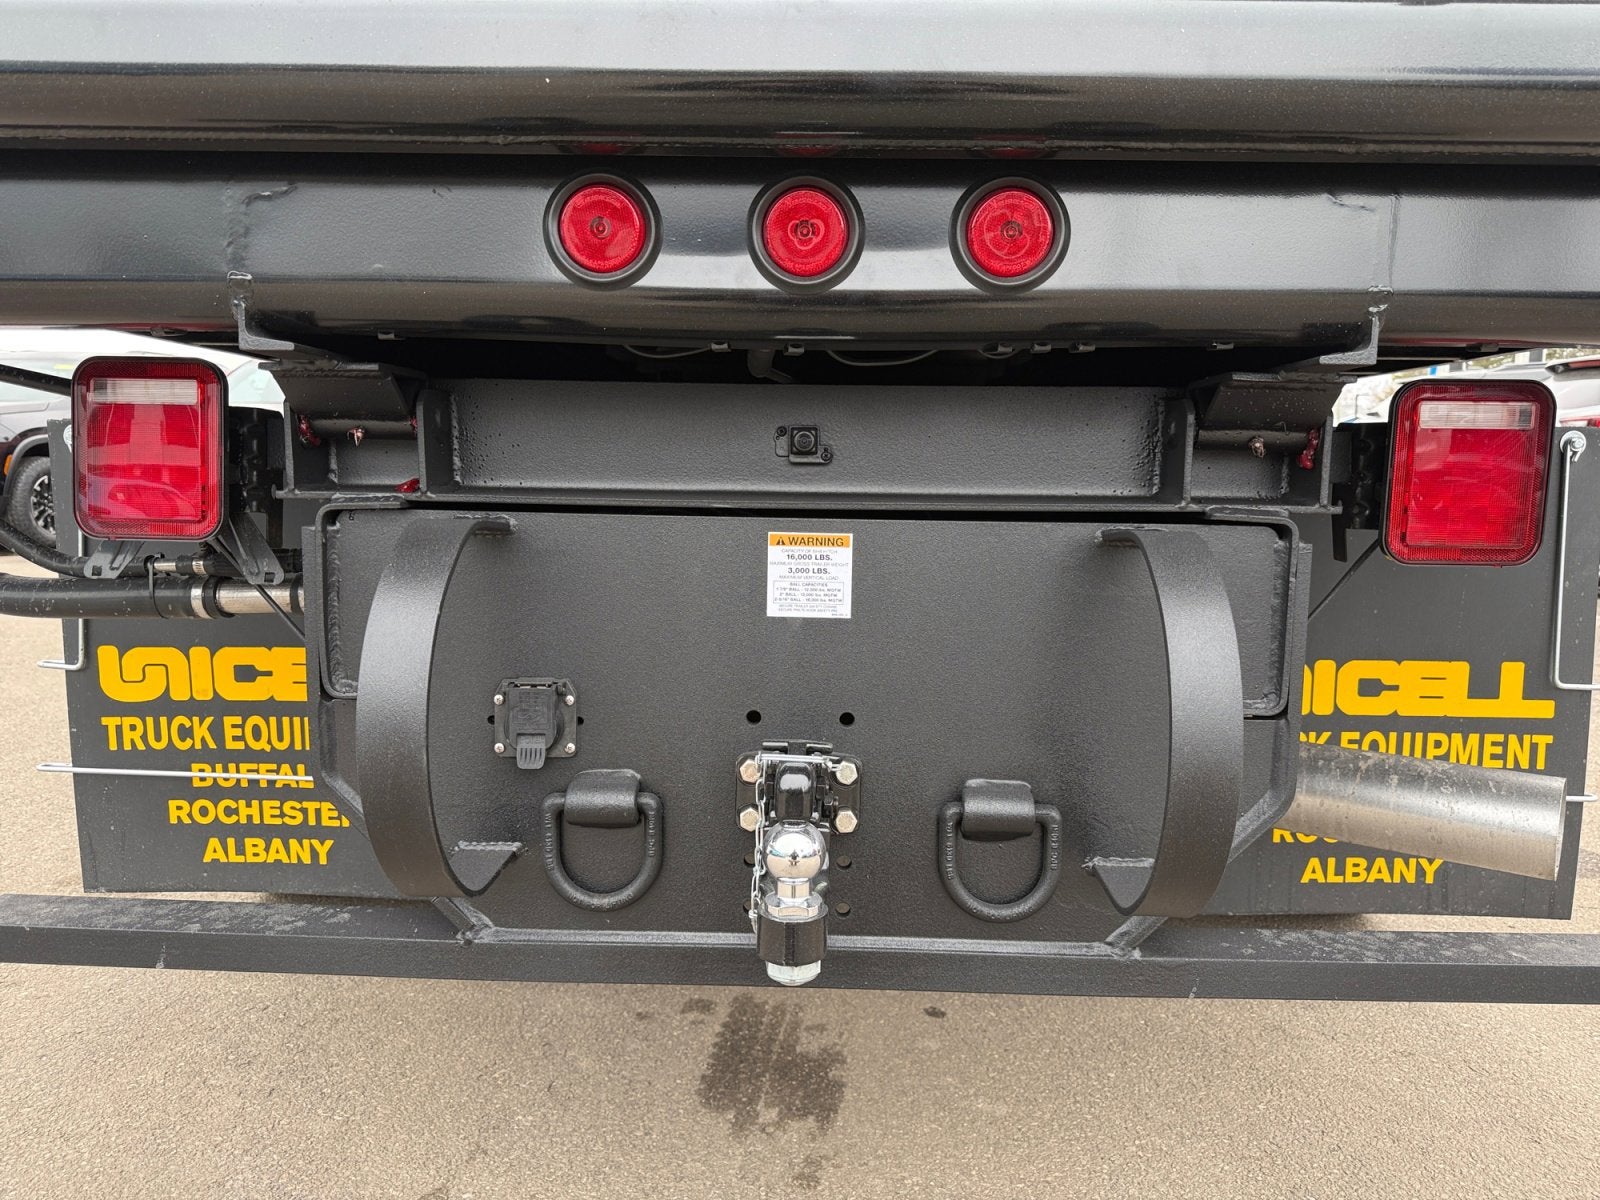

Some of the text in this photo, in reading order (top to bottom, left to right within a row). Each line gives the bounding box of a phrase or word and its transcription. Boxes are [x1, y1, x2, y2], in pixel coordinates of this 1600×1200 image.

[788, 536, 844, 547] WARNING
[101, 715, 217, 751] TRUCK
[202, 837, 335, 865] ALBANY
[1300, 856, 1445, 884] ALBANY
